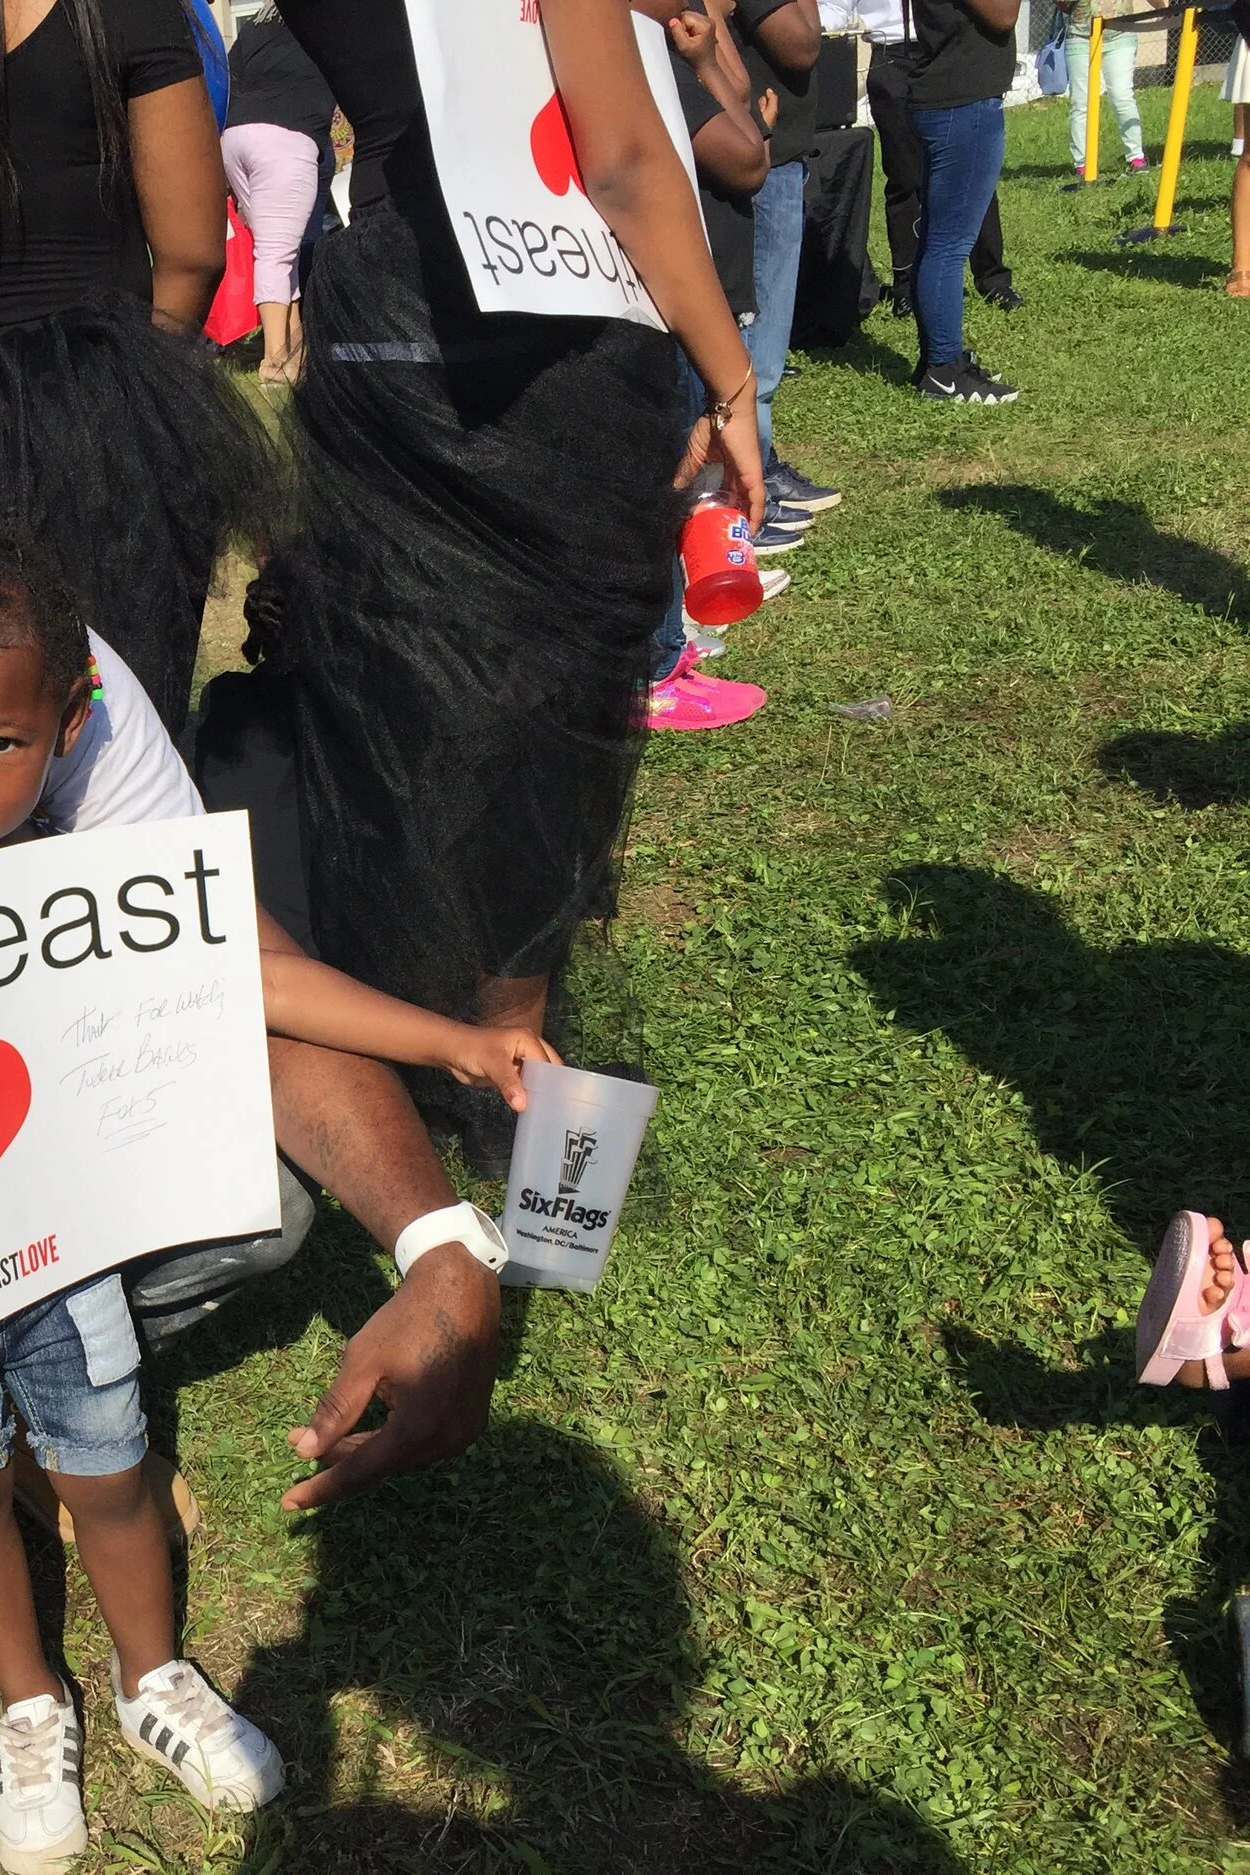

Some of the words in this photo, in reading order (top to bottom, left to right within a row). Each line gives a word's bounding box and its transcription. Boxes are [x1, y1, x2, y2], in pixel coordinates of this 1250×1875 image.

[519, 0, 539, 25] OVE
[463, 211, 642, 305] theast
[542, 1225, 578, 1240] AMERICA
